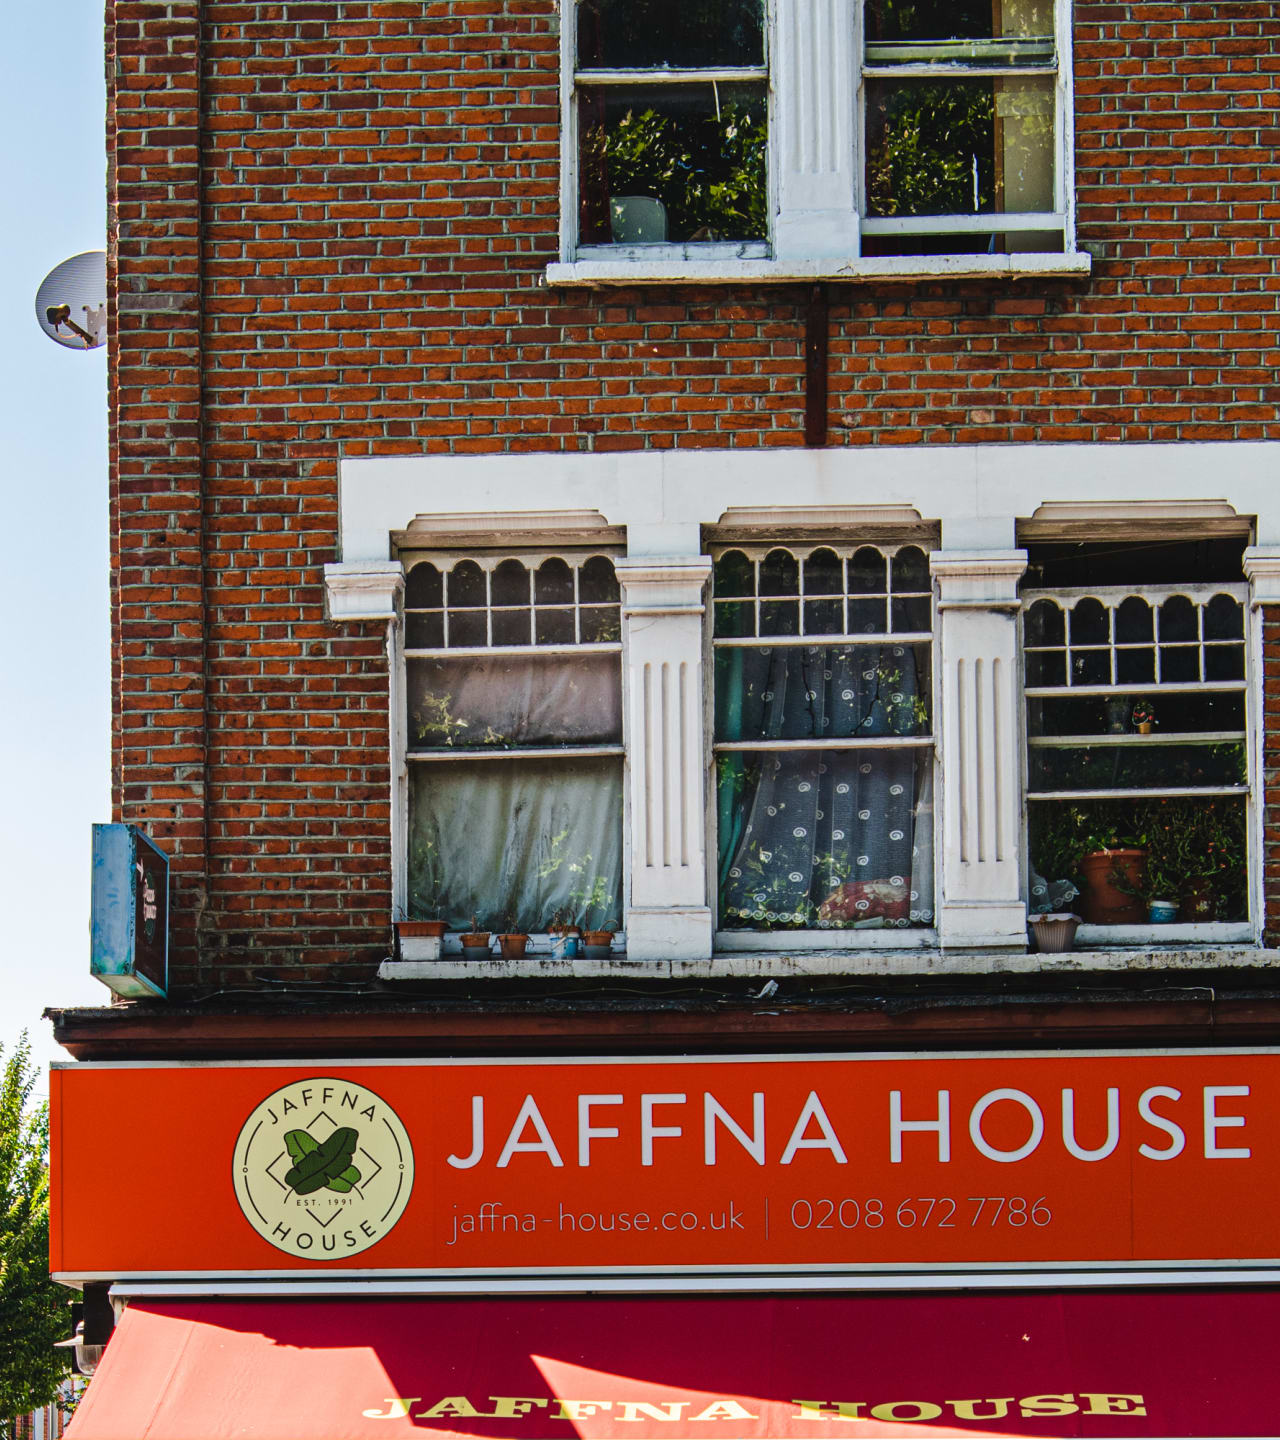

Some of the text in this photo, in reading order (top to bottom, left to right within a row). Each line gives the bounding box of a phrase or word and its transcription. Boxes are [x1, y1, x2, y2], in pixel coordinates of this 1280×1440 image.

[263, 1087, 379, 1126] JAFFNA
[446, 1085, 1252, 1170] JAFFNA HOUSE
[296, 1198, 353, 1207] EST. 1991
[446, 1195, 1053, 1246] jaffna-house.co.uk 0208 672 7786
[271, 1218, 380, 1253] HOUSE
[362, 1392, 1149, 1423] JAFFNA HOUSE
